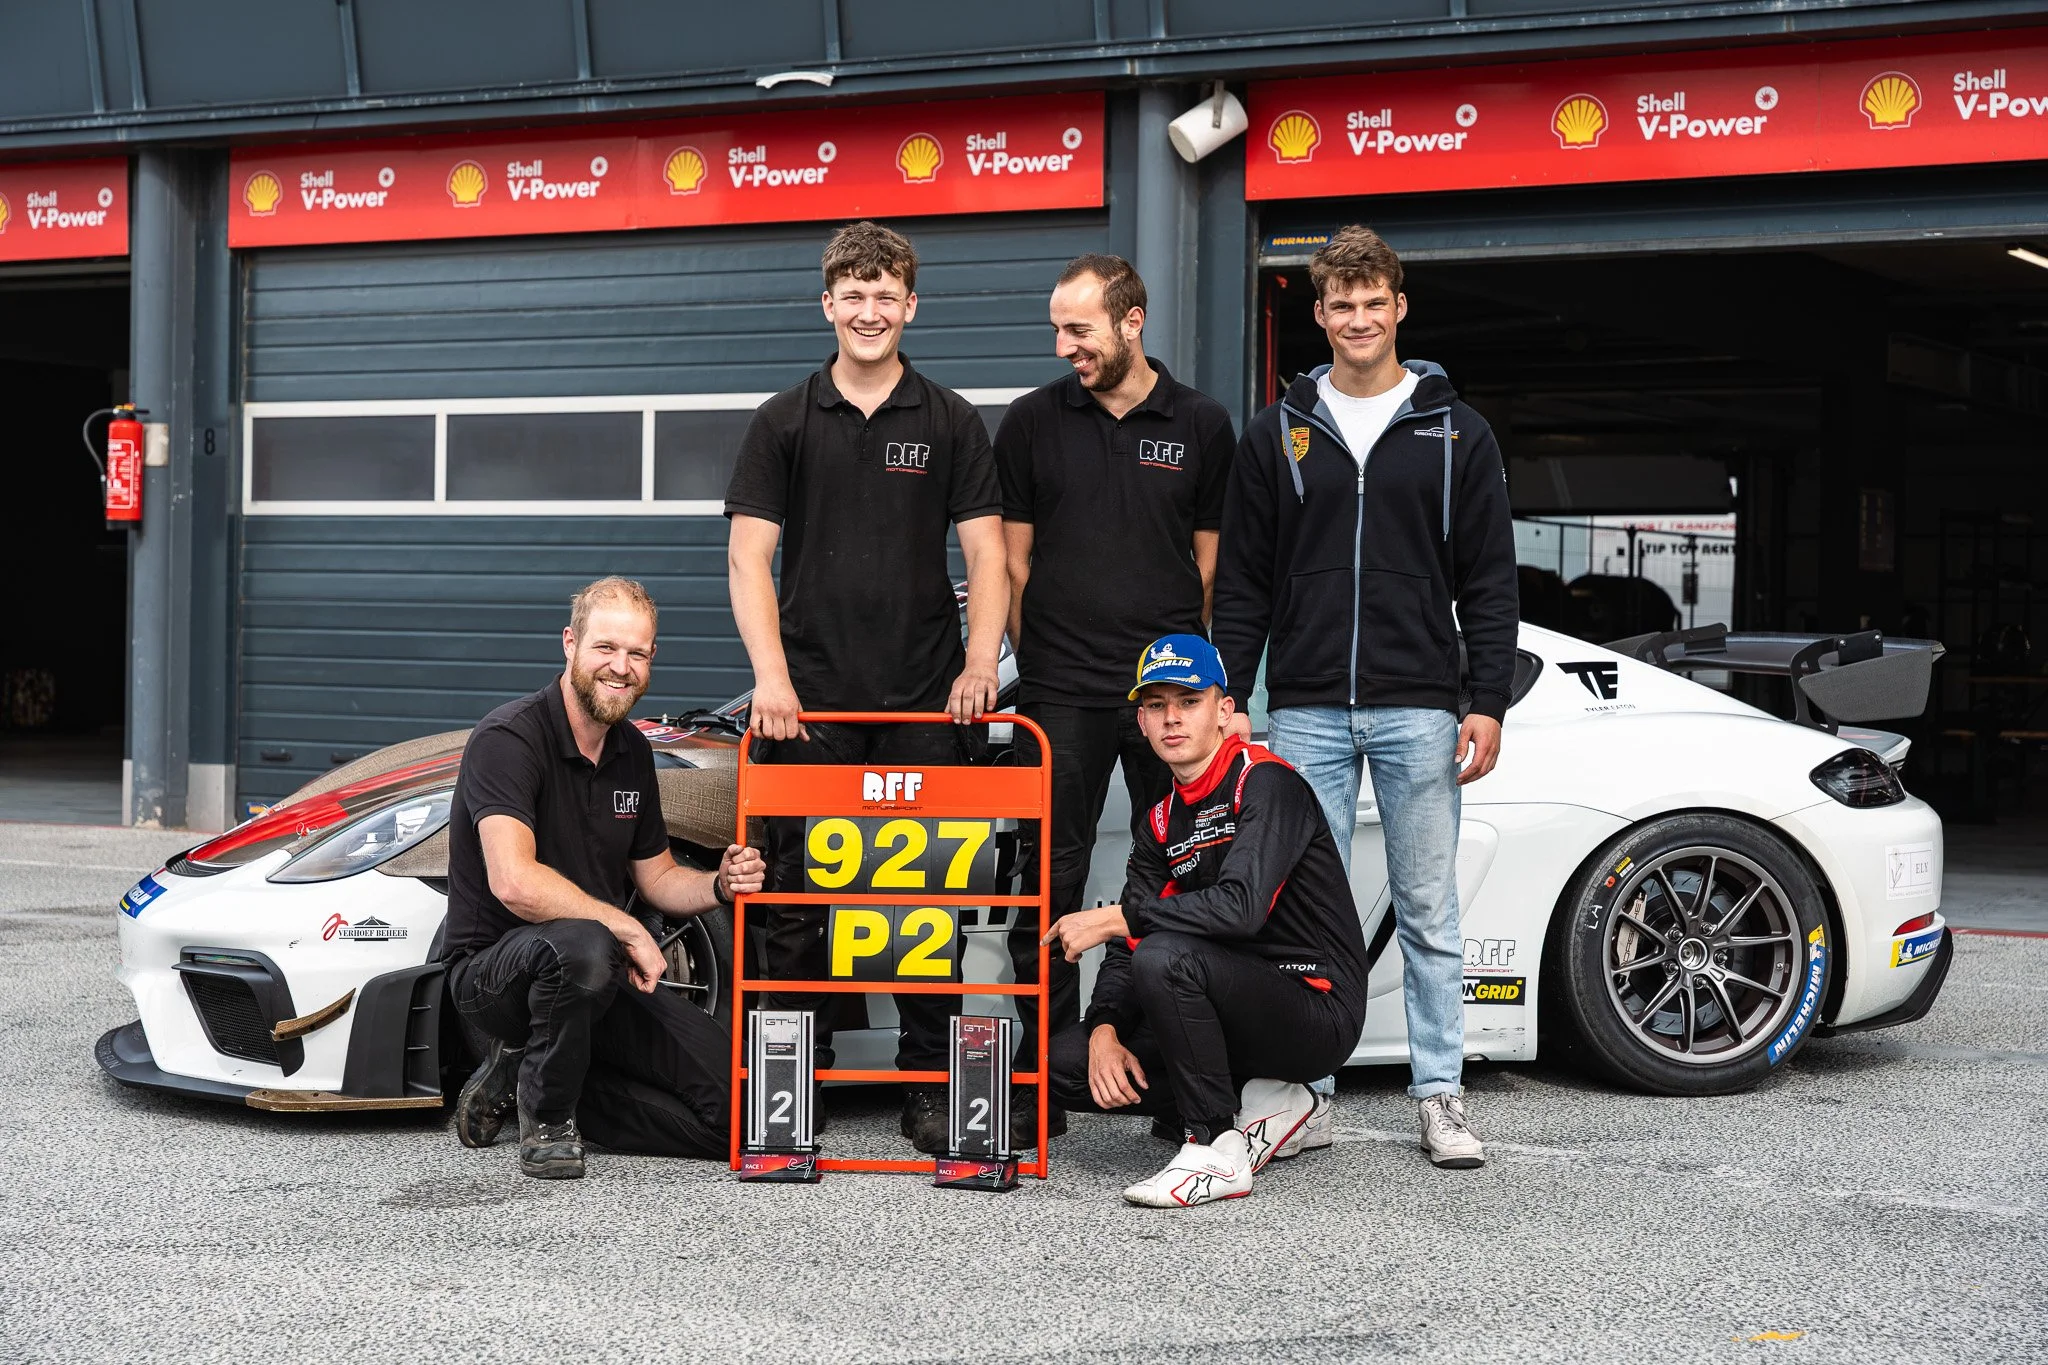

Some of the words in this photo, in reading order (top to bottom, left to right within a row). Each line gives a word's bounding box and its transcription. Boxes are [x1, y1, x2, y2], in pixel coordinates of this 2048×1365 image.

[1953, 69, 2006, 91] Shell
[1637, 92, 1686, 113] Shell
[1347, 109, 1392, 129] Shell
[1638, 114, 1768, 140] V-Power
[966, 132, 1007, 151] Shell
[1348, 131, 1468, 155] V-Power
[728, 145, 767, 164] Shell
[967, 152, 1074, 176] V-Power
[300, 171, 333, 188] Shell
[507, 160, 542, 178] Shell
[729, 166, 829, 188] V-Power
[27, 190, 58, 208] Shell
[301, 188, 389, 211] V-Power
[508, 180, 601, 201] V-Power
[27, 208, 107, 230] V-Power
[204, 428, 216, 456] 8
[1139, 439, 1185, 465] RFF
[885, 442, 931, 468] RFF
[862, 771, 924, 803] RFF
[806, 818, 991, 889] 927
[376, 929, 408, 937] BEHEER
[831, 907, 954, 977] P2
[766, 1018, 798, 1026] GT4
[1773, 964, 1822, 1058] MICHELIN
[768, 1090, 793, 1123] 2
[966, 1097, 990, 1131] 2
